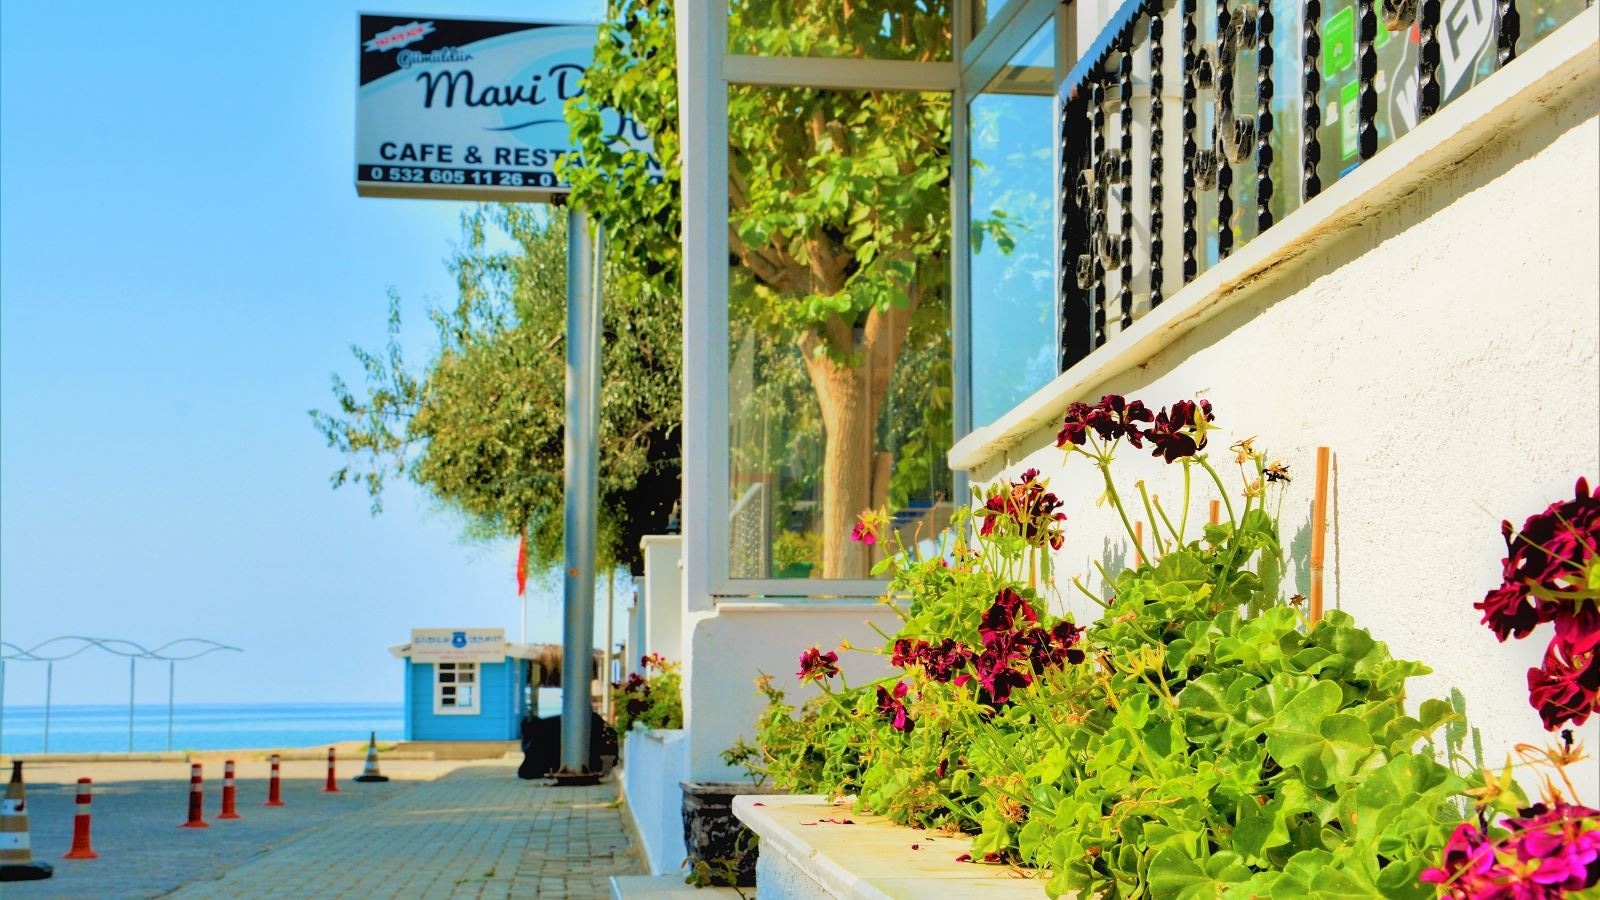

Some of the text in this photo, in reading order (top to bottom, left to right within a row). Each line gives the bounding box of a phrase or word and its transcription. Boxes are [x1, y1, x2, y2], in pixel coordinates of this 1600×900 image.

[397, 47, 474, 69] Gümüldür
[416, 69, 546, 109] Mavi
[380, 142, 453, 164] CAFE
[464, 145, 482, 165] &
[371, 166, 383, 180] 0
[389, 167, 424, 182] 532
[430, 169, 465, 184] 605
[471, 171, 492, 185] 11
[500, 172, 523, 186] 26
[540, 173, 551, 187] 0
